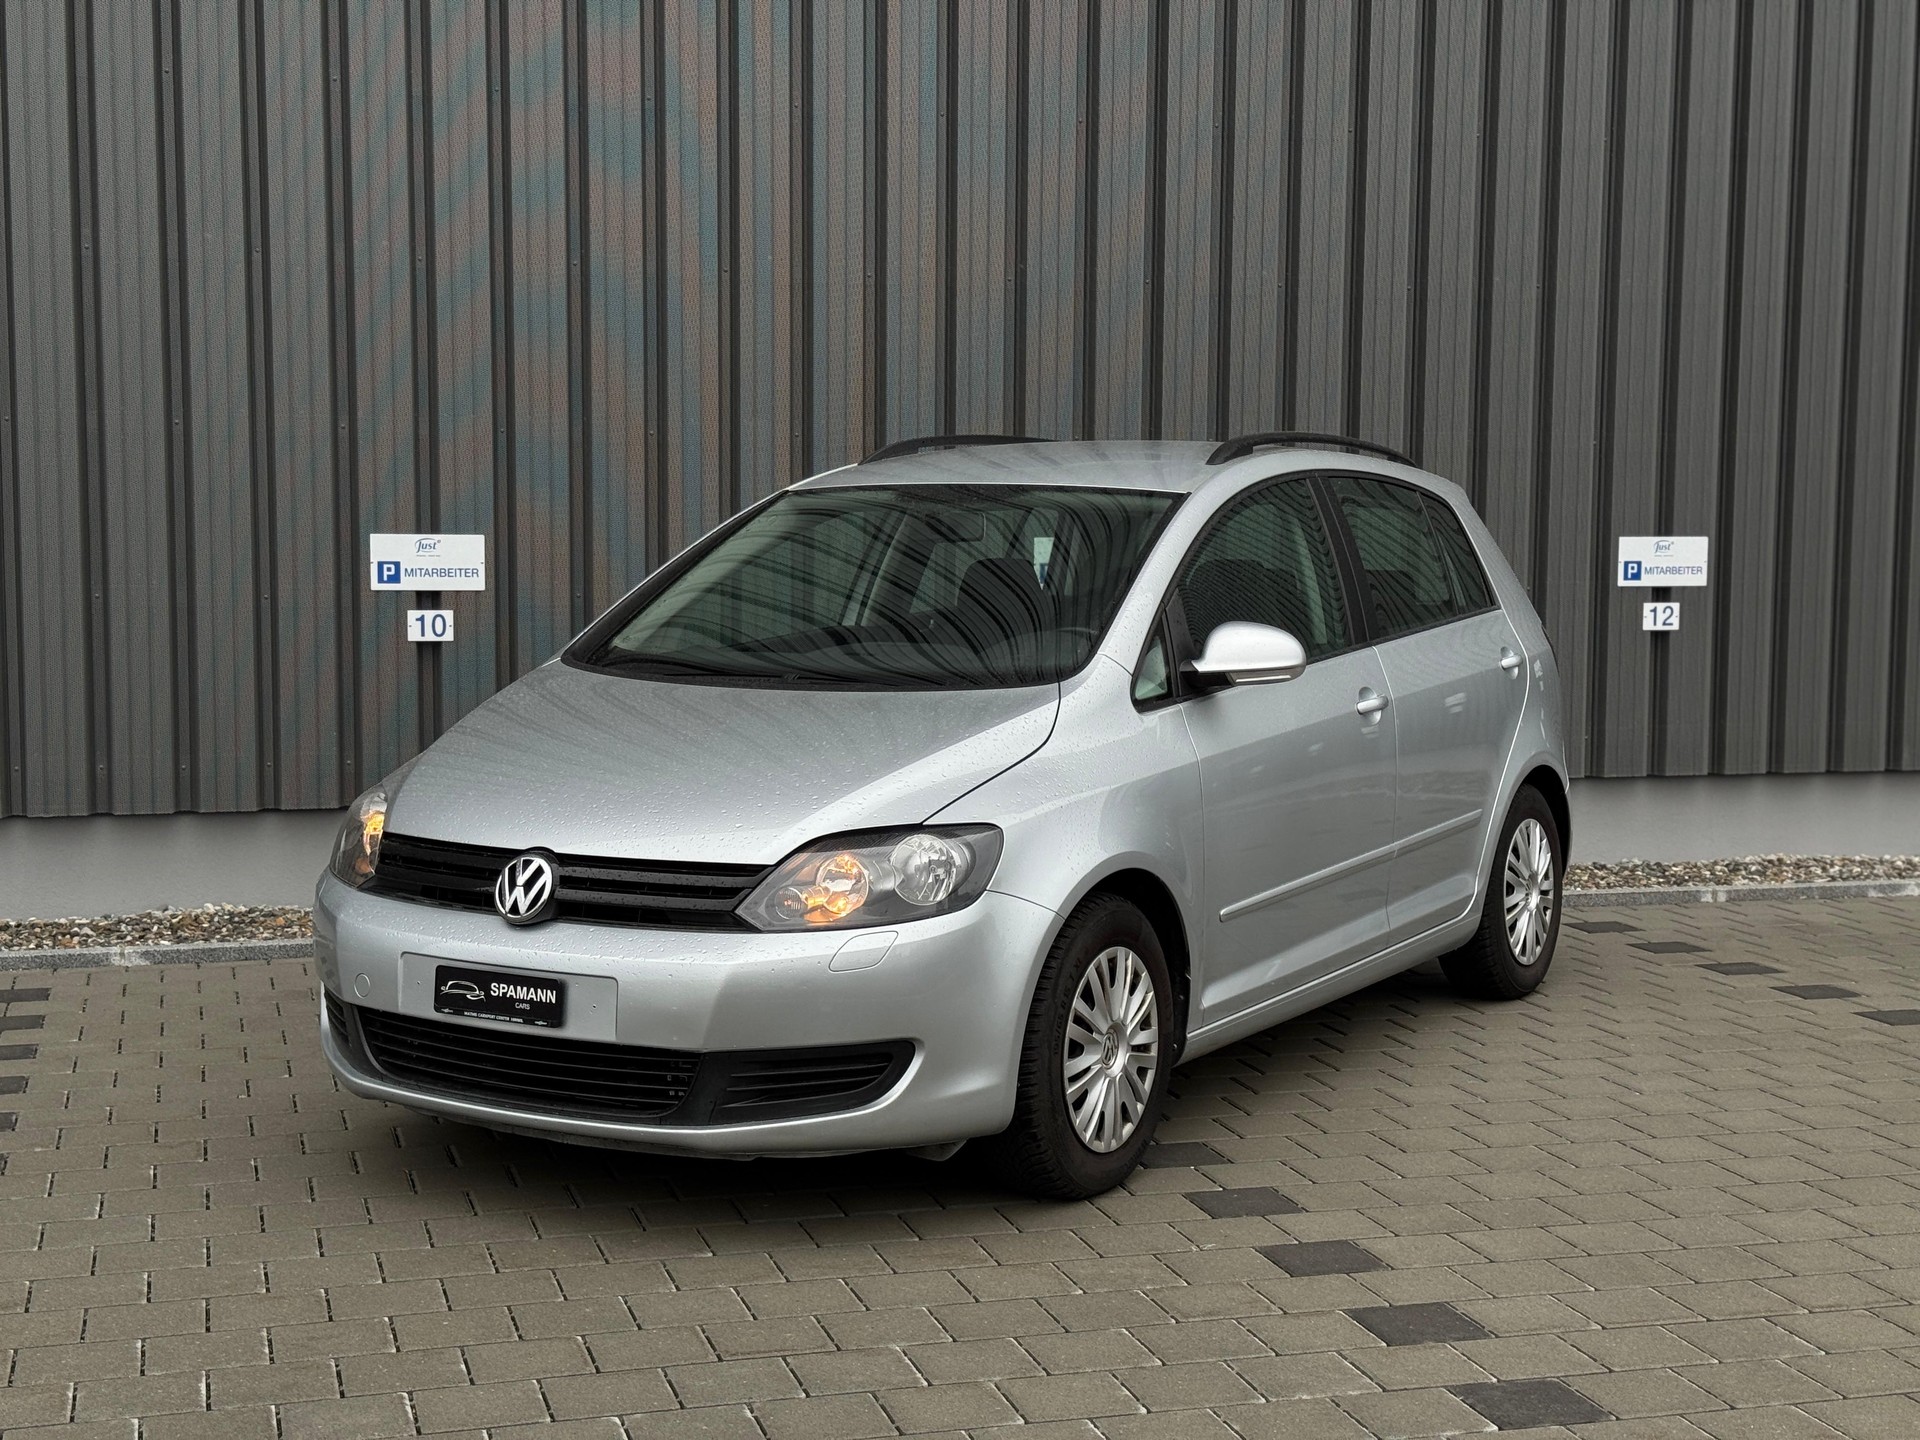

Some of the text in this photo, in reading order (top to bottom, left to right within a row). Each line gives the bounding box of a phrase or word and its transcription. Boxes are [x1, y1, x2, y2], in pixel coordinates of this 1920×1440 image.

[416, 541, 436, 553] Just
[383, 563, 480, 581] P MITARBEITER
[1627, 563, 1703, 579] P MITARBEITER
[415, 613, 447, 637] 10
[1649, 605, 1675, 627] 12
[495, 856, 553, 918] VW
[490, 982, 556, 1004] SPAMANN
[514, 1001, 531, 1010] CARS
